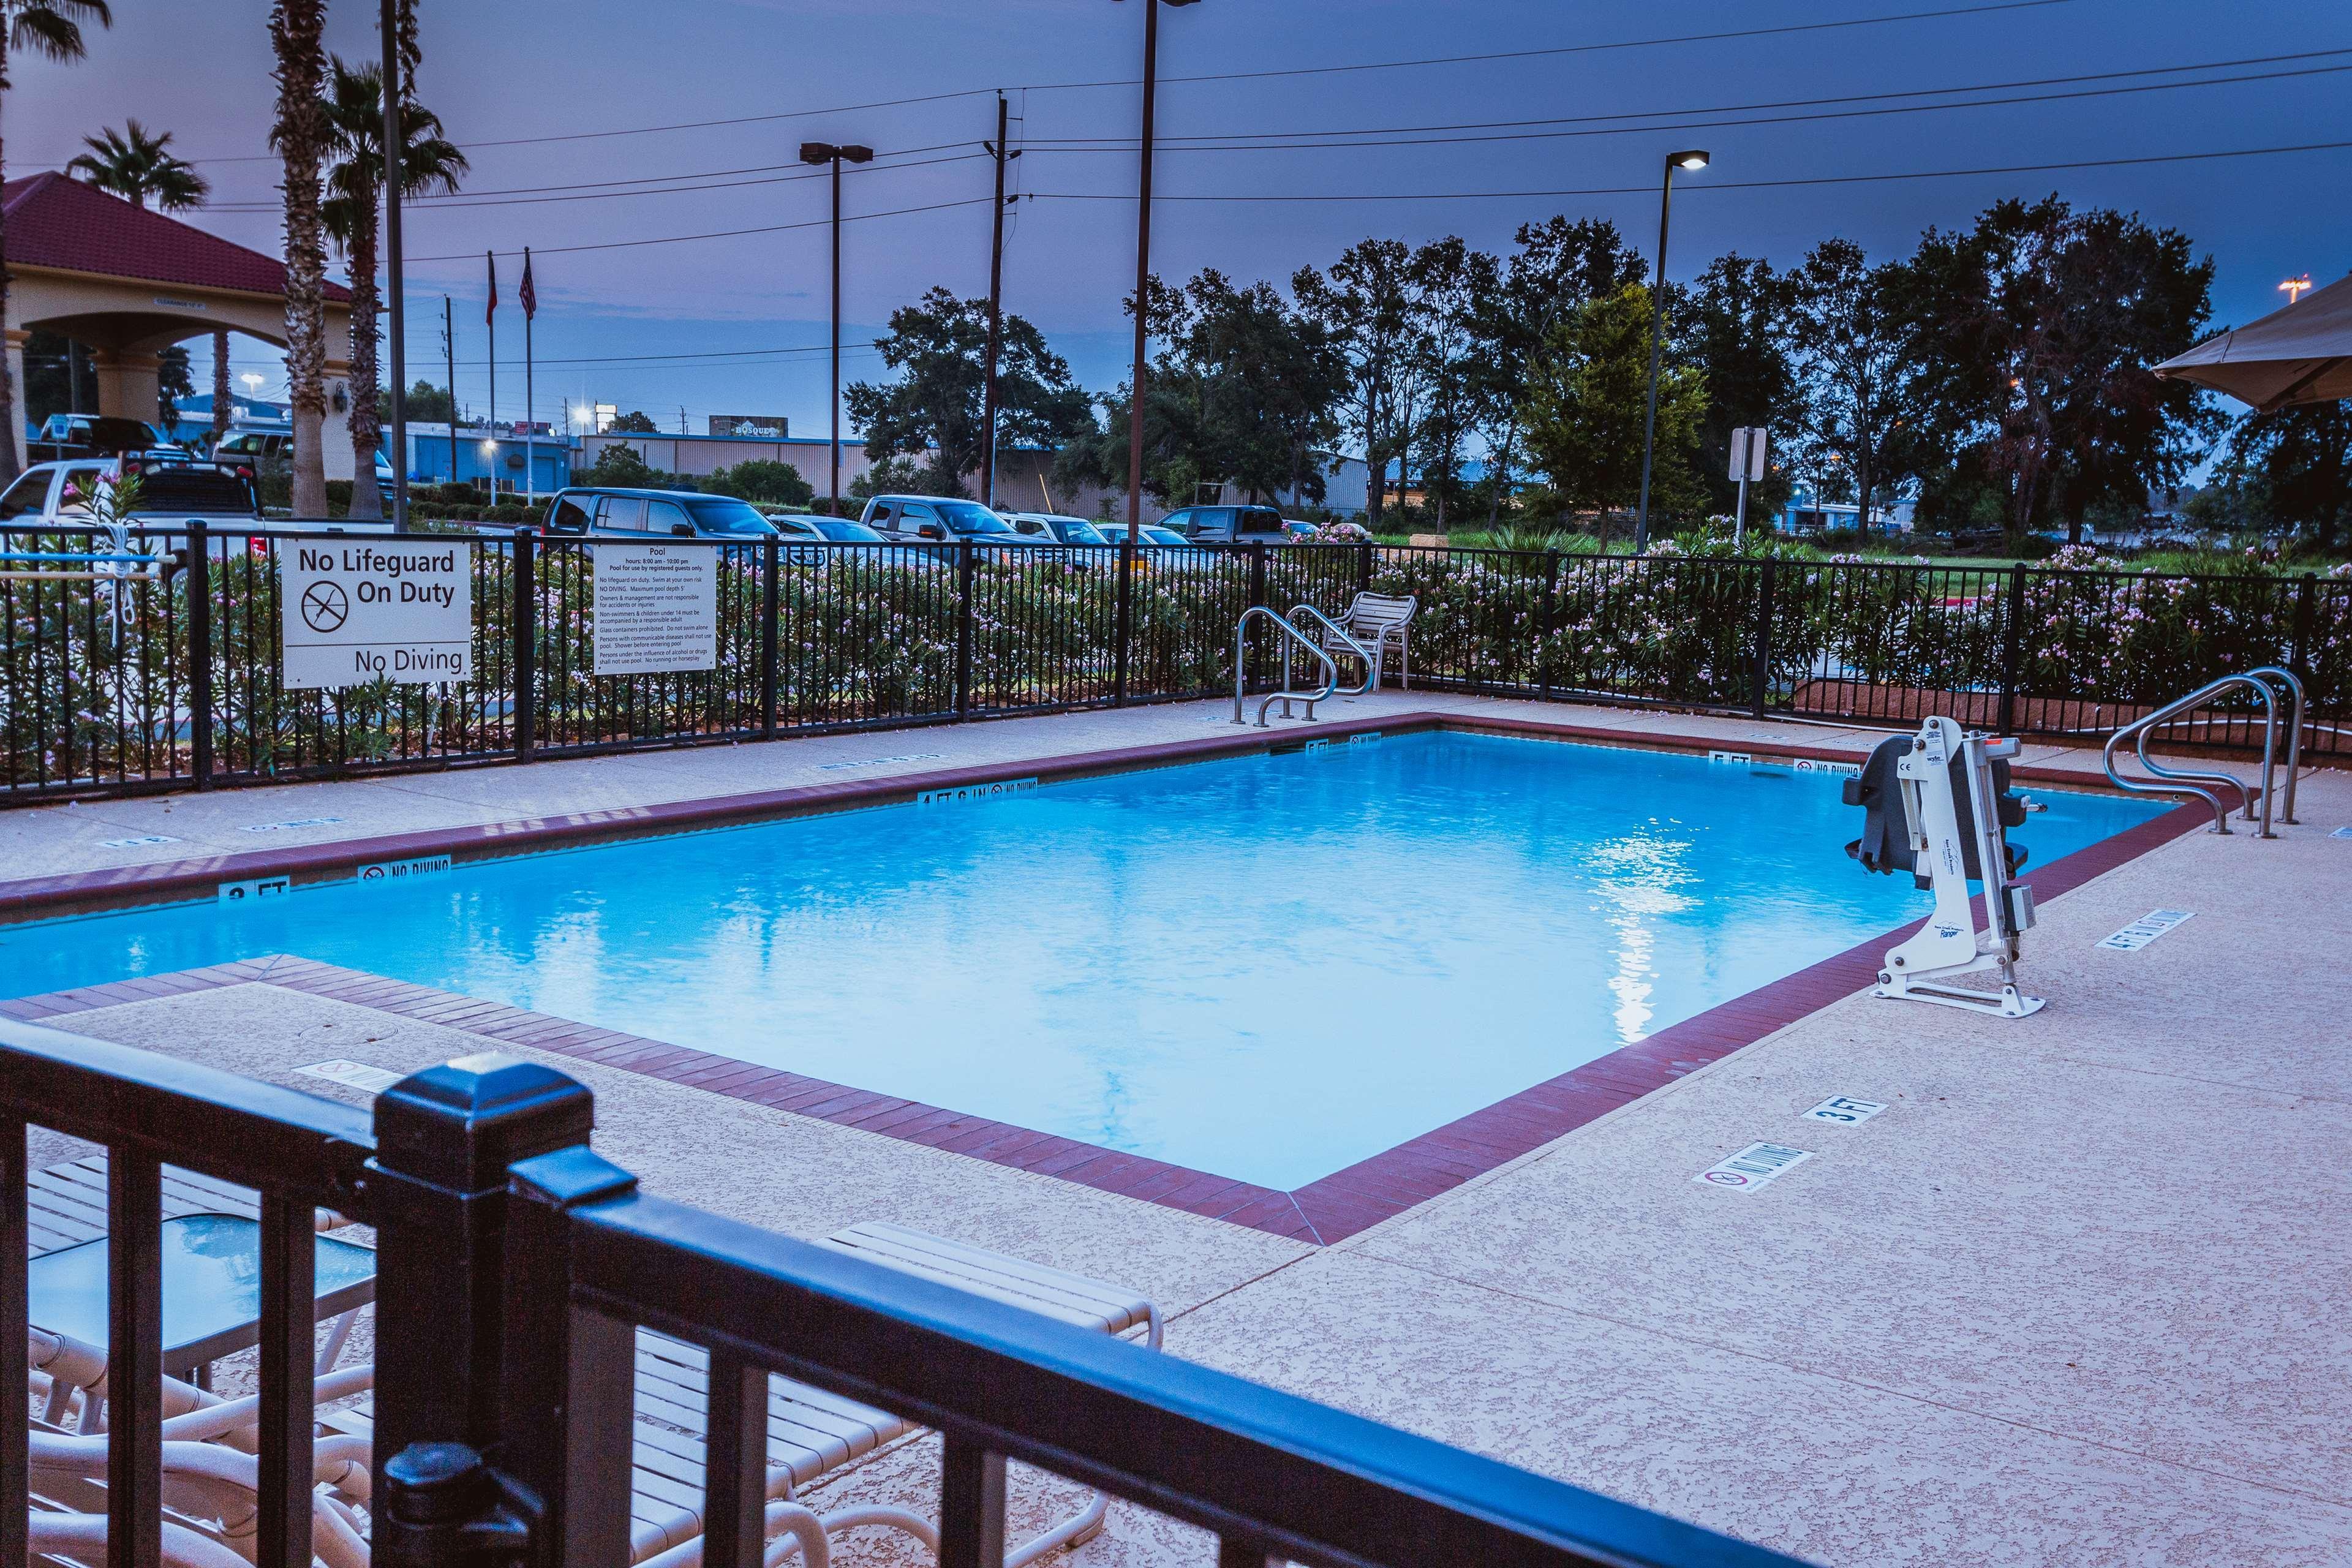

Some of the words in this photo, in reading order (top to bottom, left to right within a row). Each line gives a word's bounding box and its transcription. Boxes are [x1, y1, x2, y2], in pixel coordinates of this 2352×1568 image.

[300, 549, 334, 571] No
[343, 548, 454, 578] Lifeguard
[357, 581, 391, 603] On
[401, 581, 454, 608] Duty
[355, 650, 386, 672] No
[394, 648, 462, 675] Diving
[1940, 929, 1958, 938] Ranger
[1829, 1098, 1878, 1114] FT
[1815, 1110, 1856, 1122] 3
[1740, 1145, 1804, 1167] DIVING
[1725, 1161, 1774, 1175] NO
